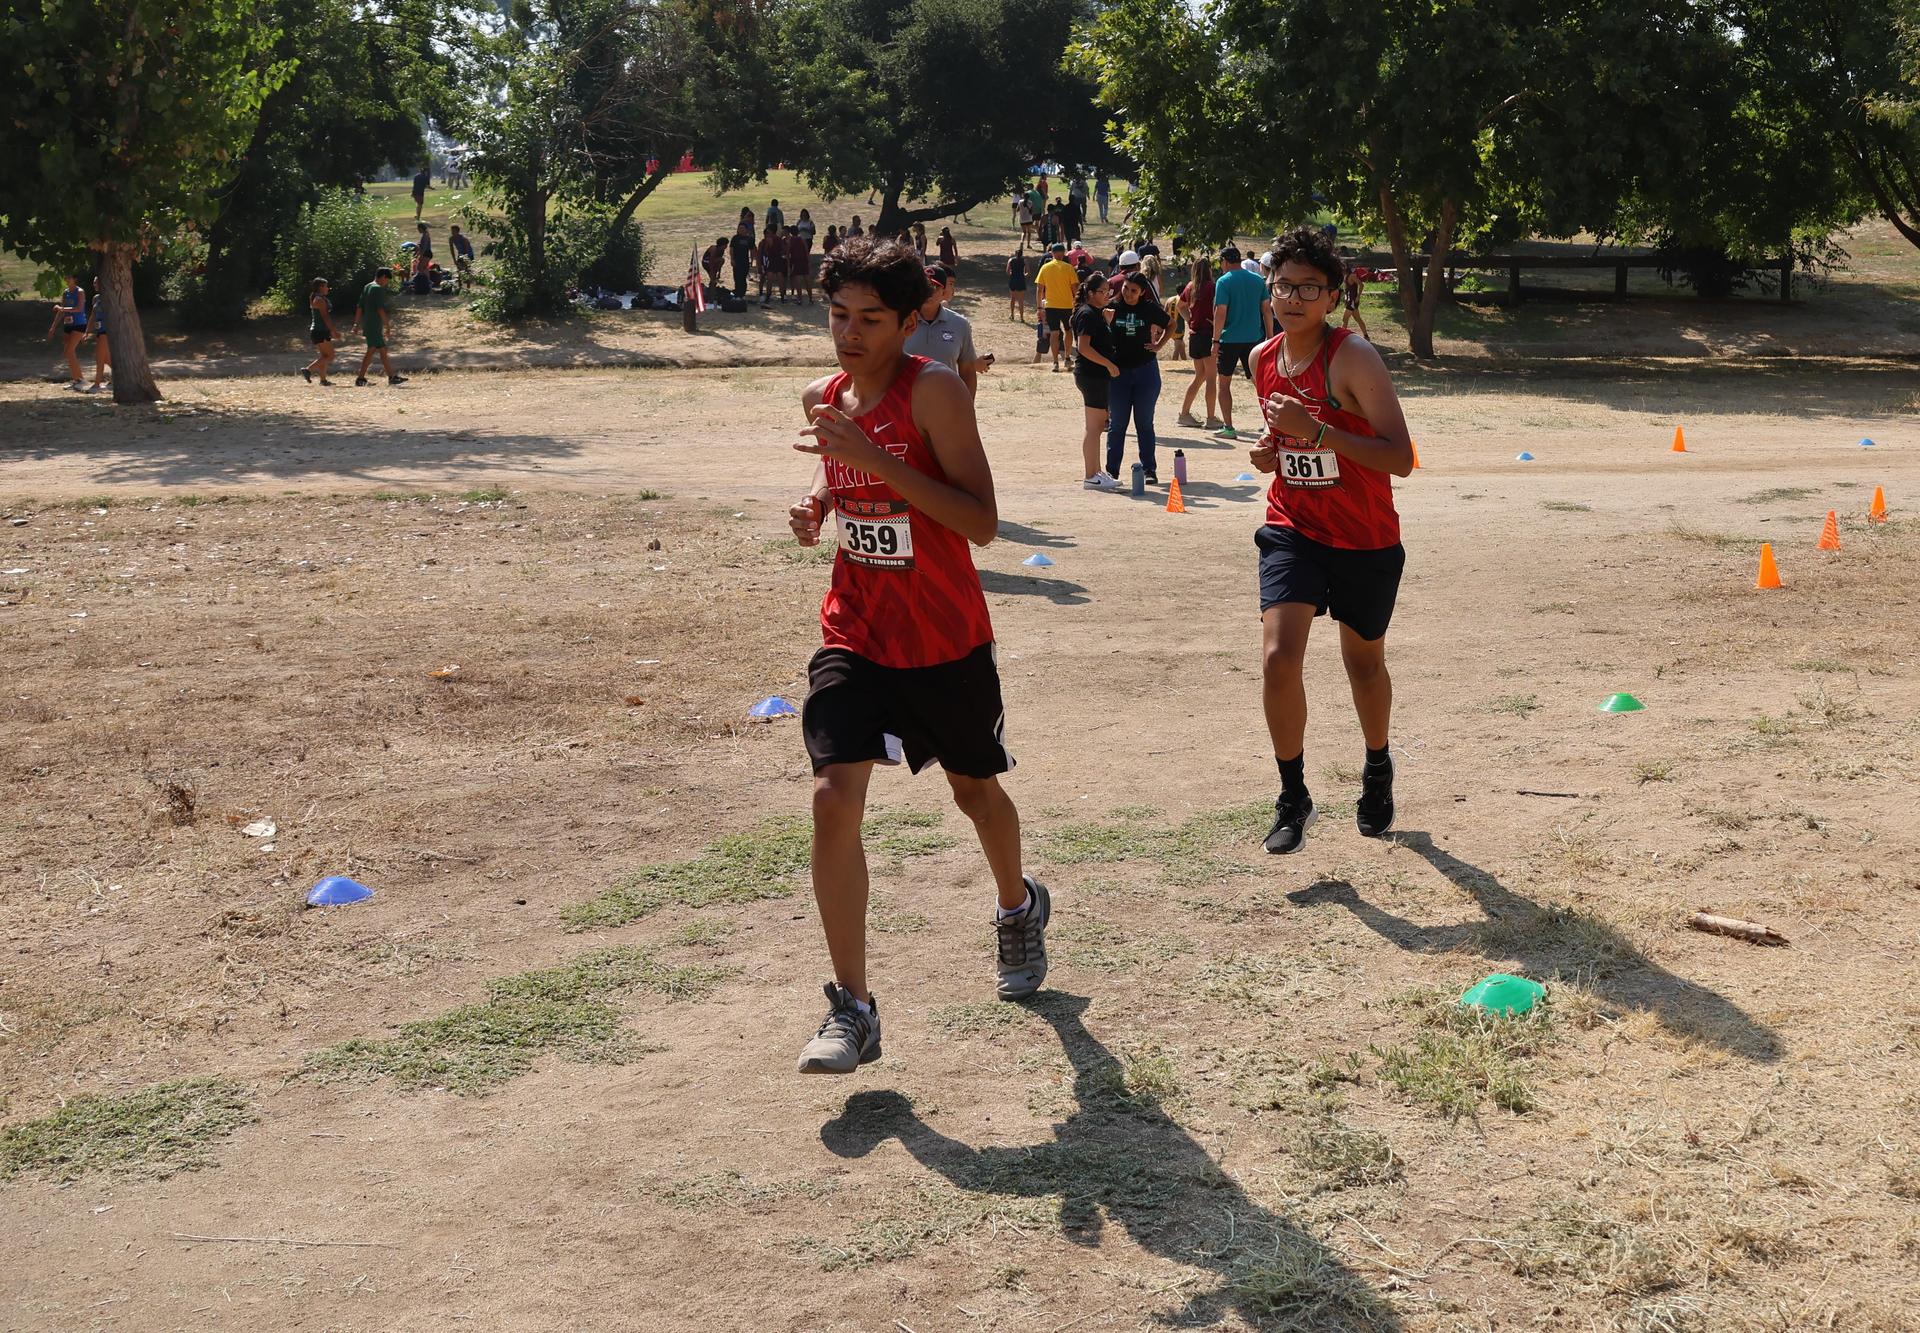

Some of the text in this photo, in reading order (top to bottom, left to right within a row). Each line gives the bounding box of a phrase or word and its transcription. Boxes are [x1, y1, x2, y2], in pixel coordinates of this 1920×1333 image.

[1286, 454, 1324, 478] 361
[845, 521, 898, 555] 359
[868, 557, 905, 566] TIMING
